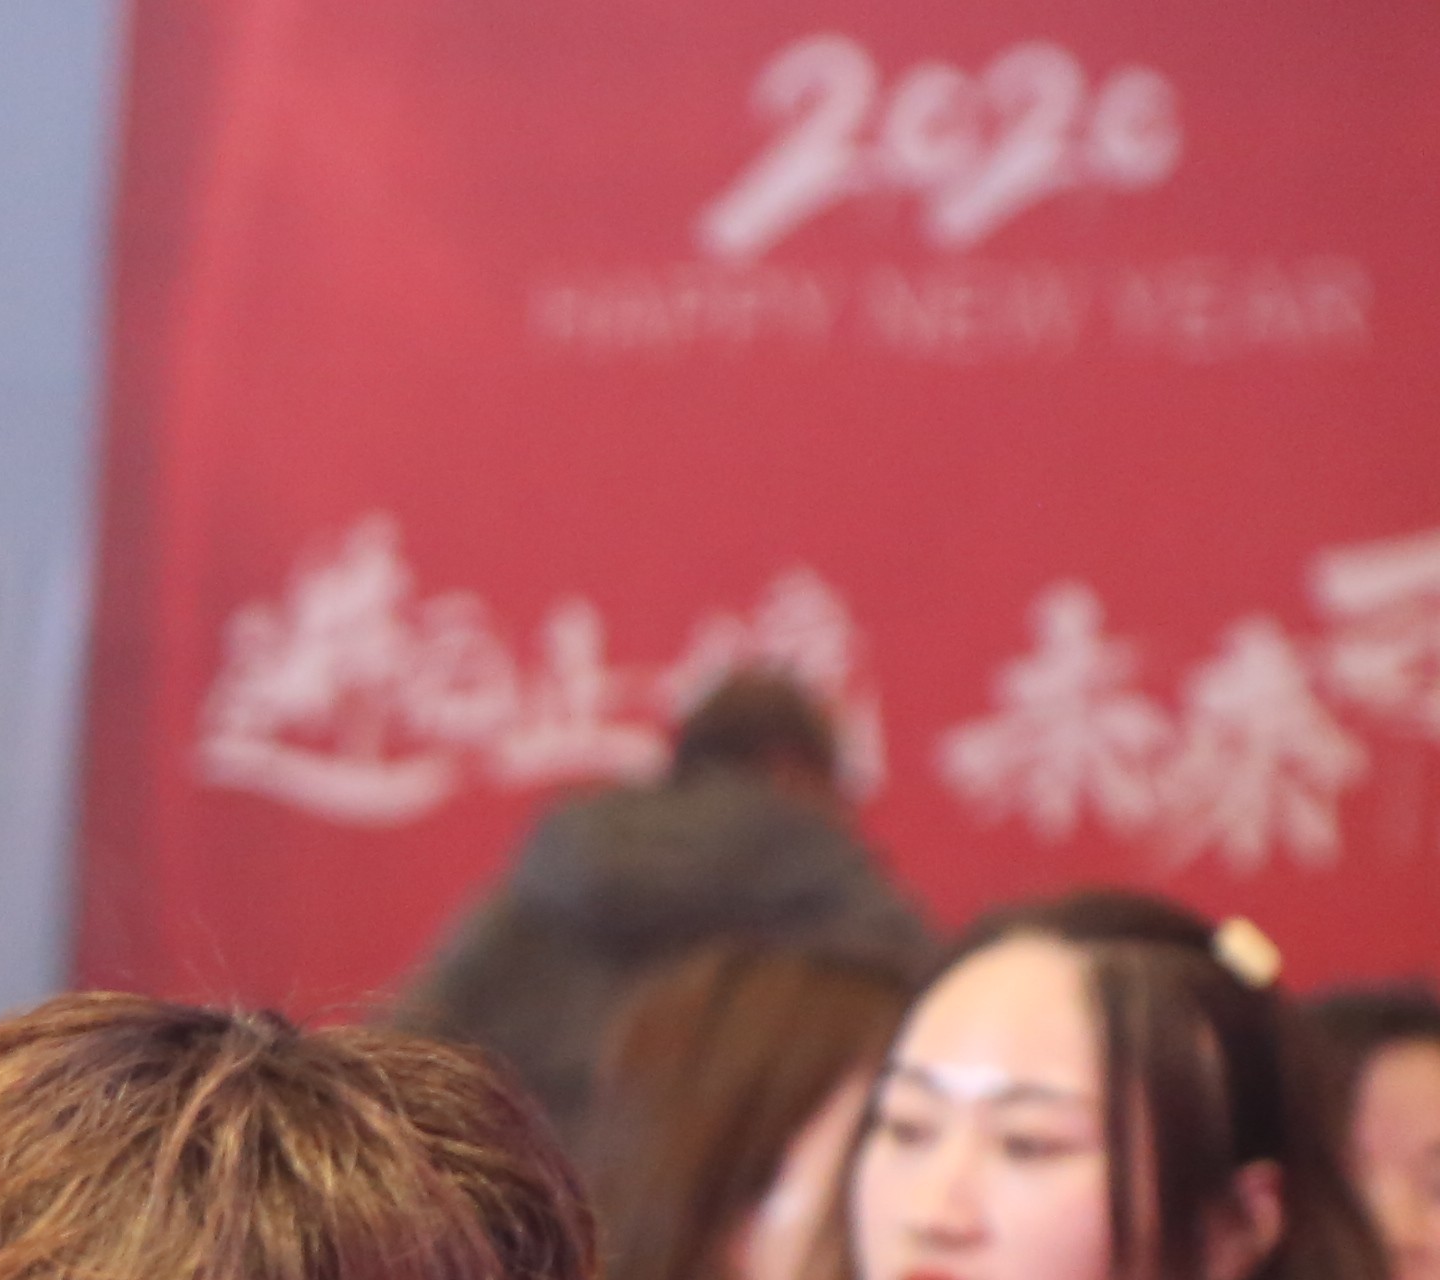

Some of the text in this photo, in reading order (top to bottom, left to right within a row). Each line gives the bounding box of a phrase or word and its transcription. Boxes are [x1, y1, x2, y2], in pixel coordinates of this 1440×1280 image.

[700, 36, 1180, 258] 2020
[538, 262, 1368, 350] HAPPY NEW YEAR
